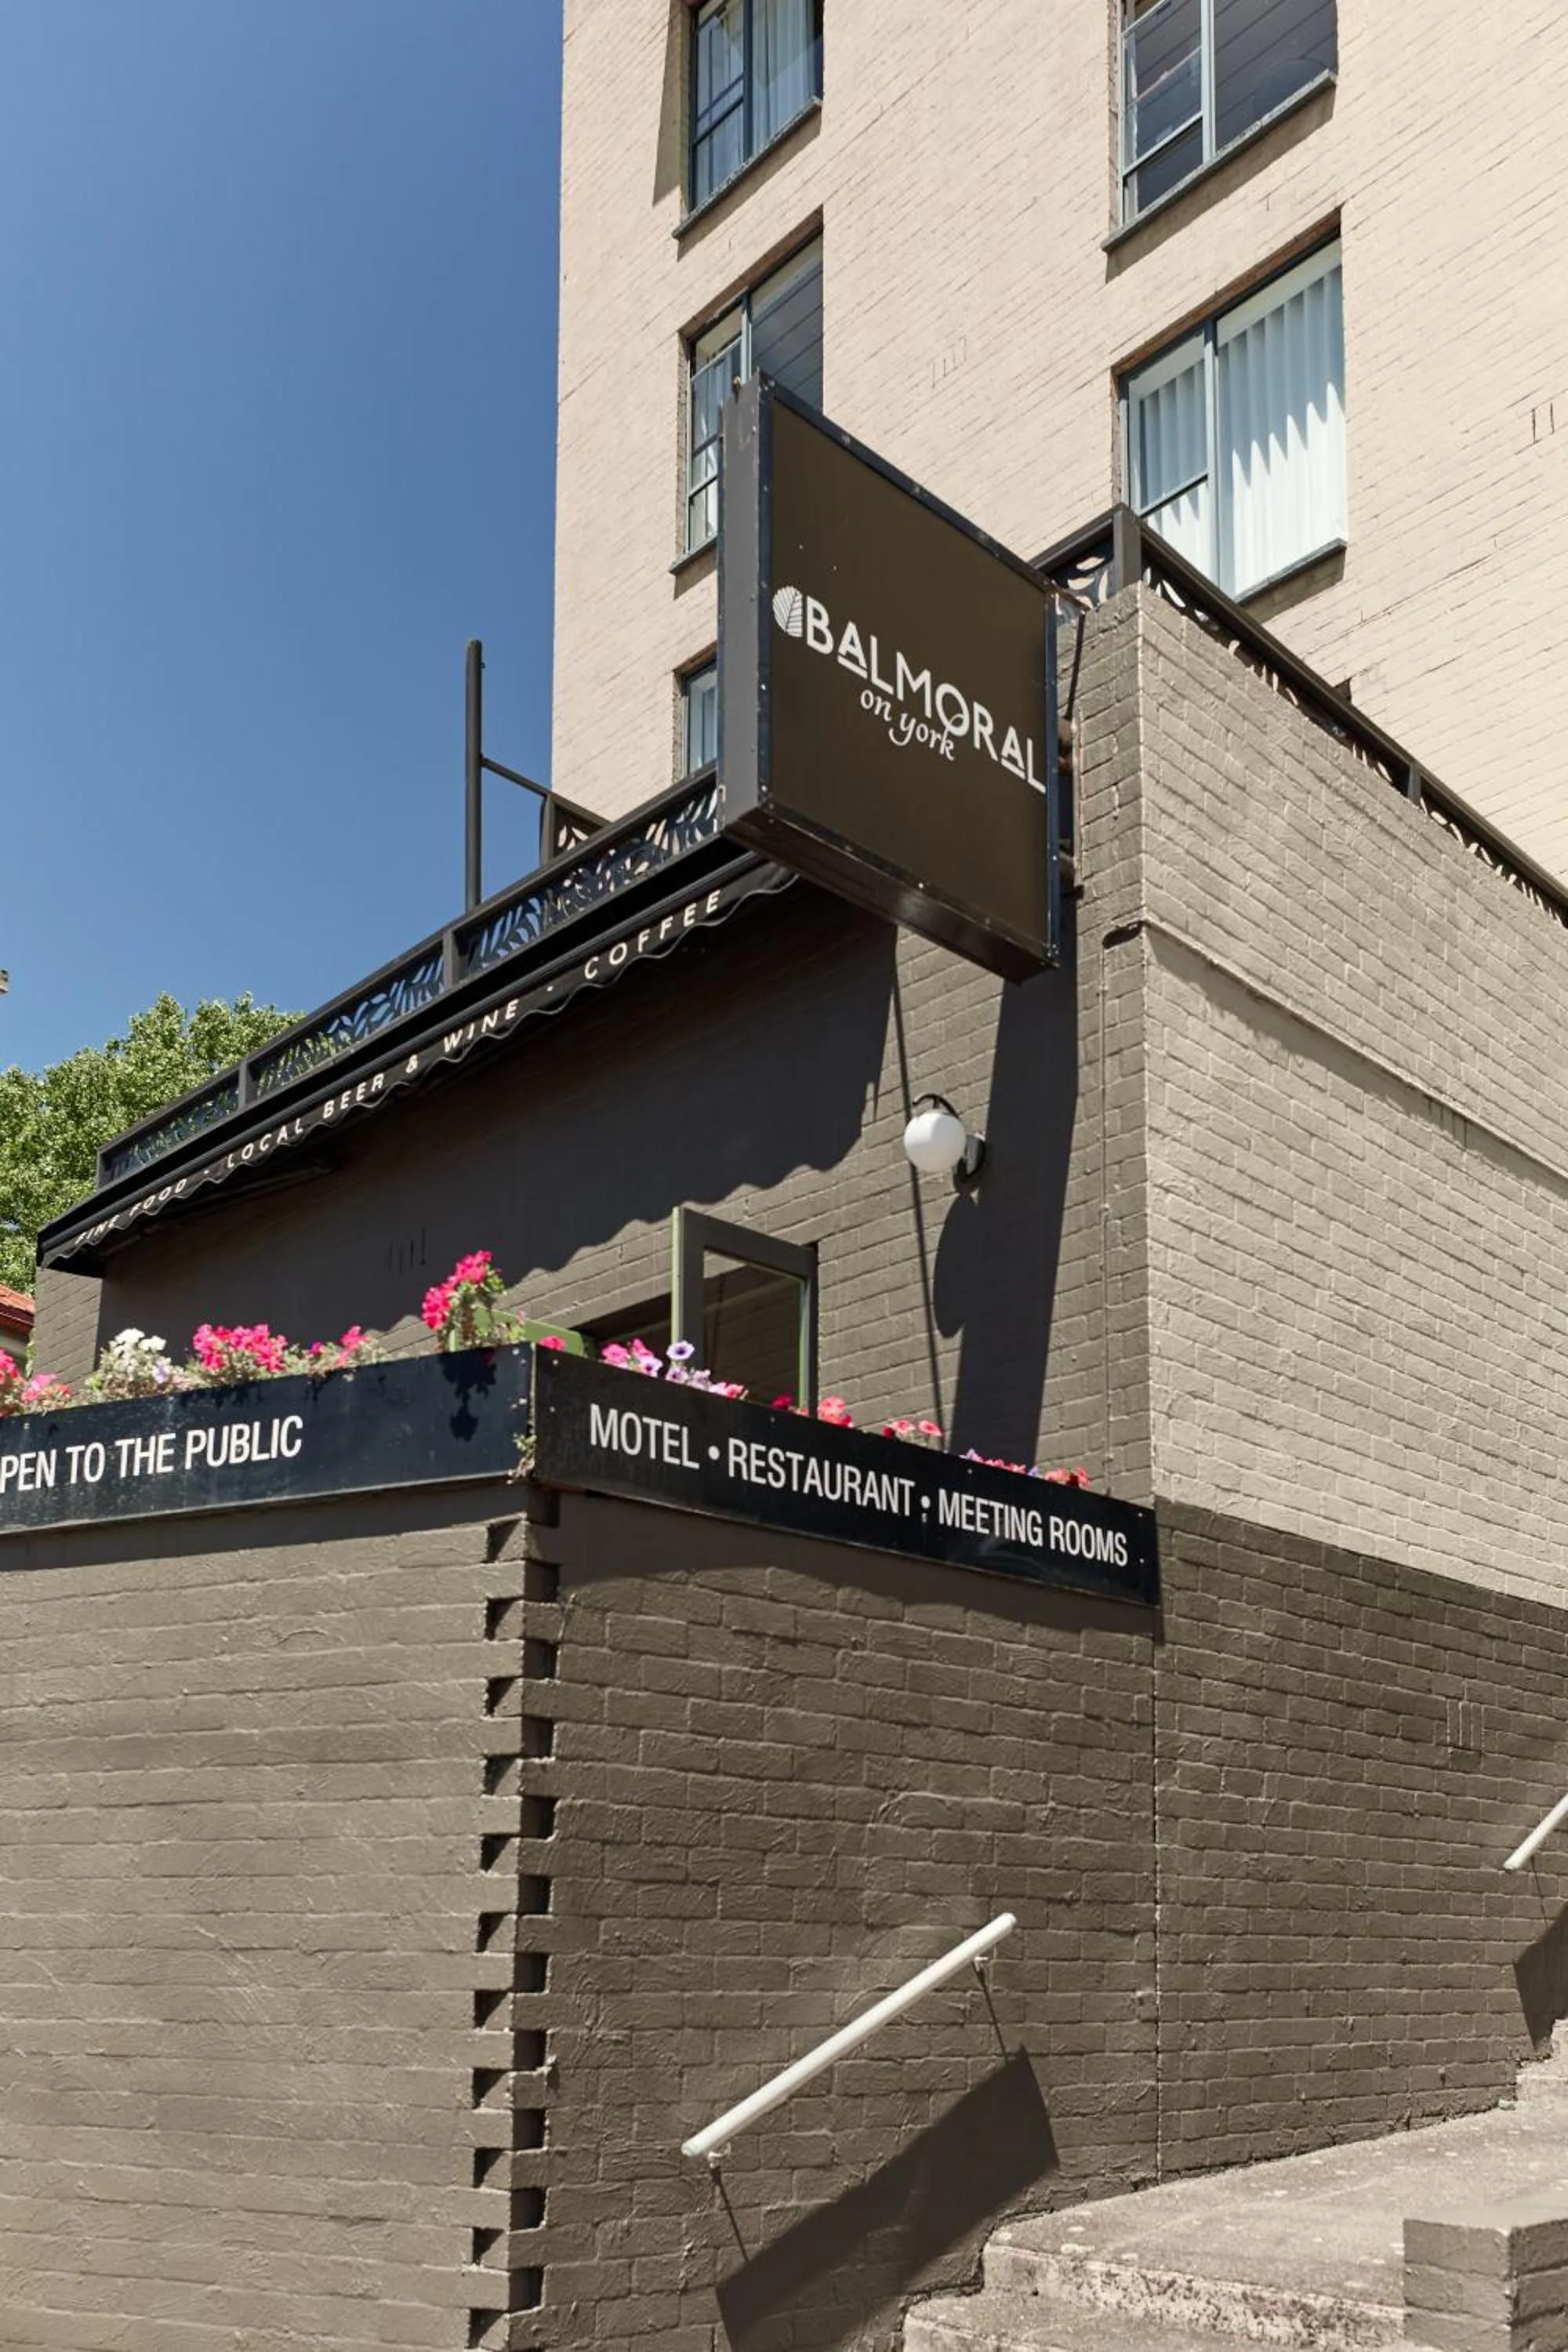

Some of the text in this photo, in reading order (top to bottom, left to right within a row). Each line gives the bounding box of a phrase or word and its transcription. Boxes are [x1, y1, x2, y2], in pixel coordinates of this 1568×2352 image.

[807, 596, 1047, 794] BALMORAL
[860, 689, 955, 760] on york
[75, 889, 721, 1245] FINE FOOD LOCAL BEER & WINE COFFEE
[66, 1442, 107, 1484] TO
[115, 1432, 176, 1478] THE
[185, 1415, 303, 1470] PUBLIC
[590, 1403, 1128, 1566] MOTEL RESTAURANT MEETING ROOMS
